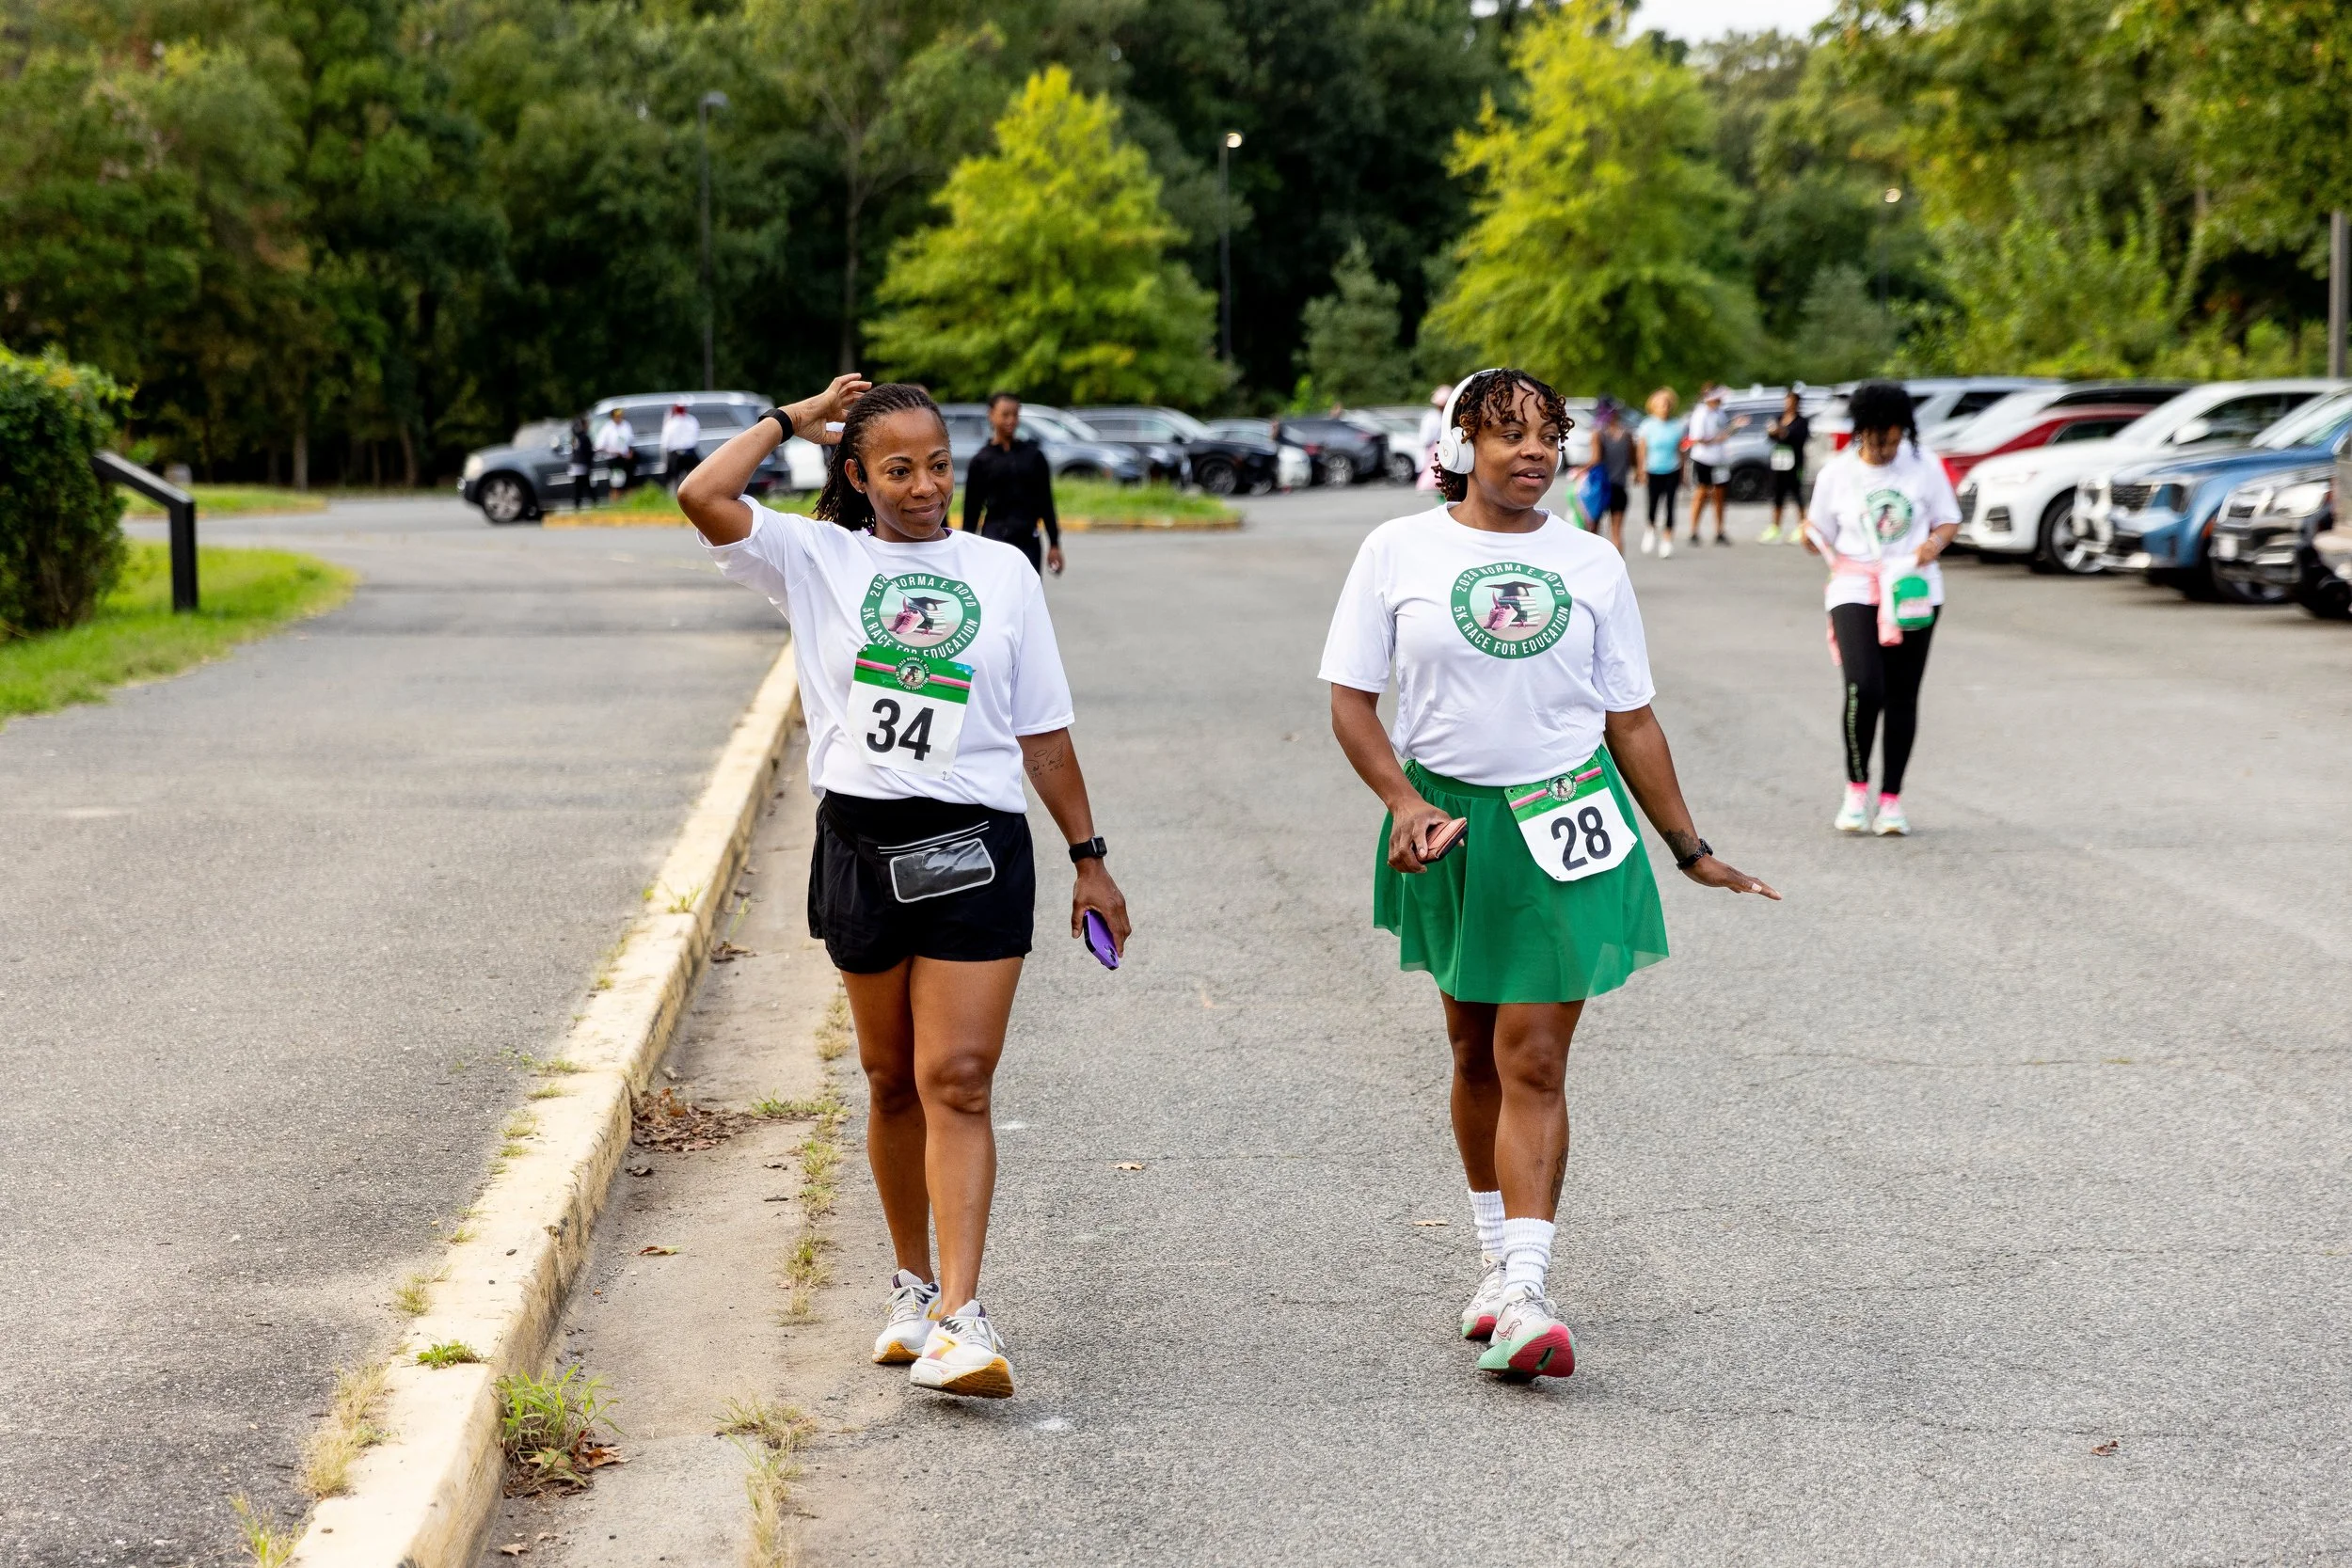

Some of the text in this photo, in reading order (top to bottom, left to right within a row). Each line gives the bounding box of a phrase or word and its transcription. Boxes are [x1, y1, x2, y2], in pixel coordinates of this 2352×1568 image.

[940, 580, 949, 591] E.
[953, 583, 977, 608] BOYD
[1479, 563, 1521, 577] NORMA
[1526, 567, 1537, 577] E.
[1541, 571, 1566, 596] BOYD
[863, 608, 875, 621] 5K
[1454, 605, 1569, 656] 5K RACE FOR EDUCATION
[866, 698, 935, 761] 34
[1550, 805, 1612, 871] 28
